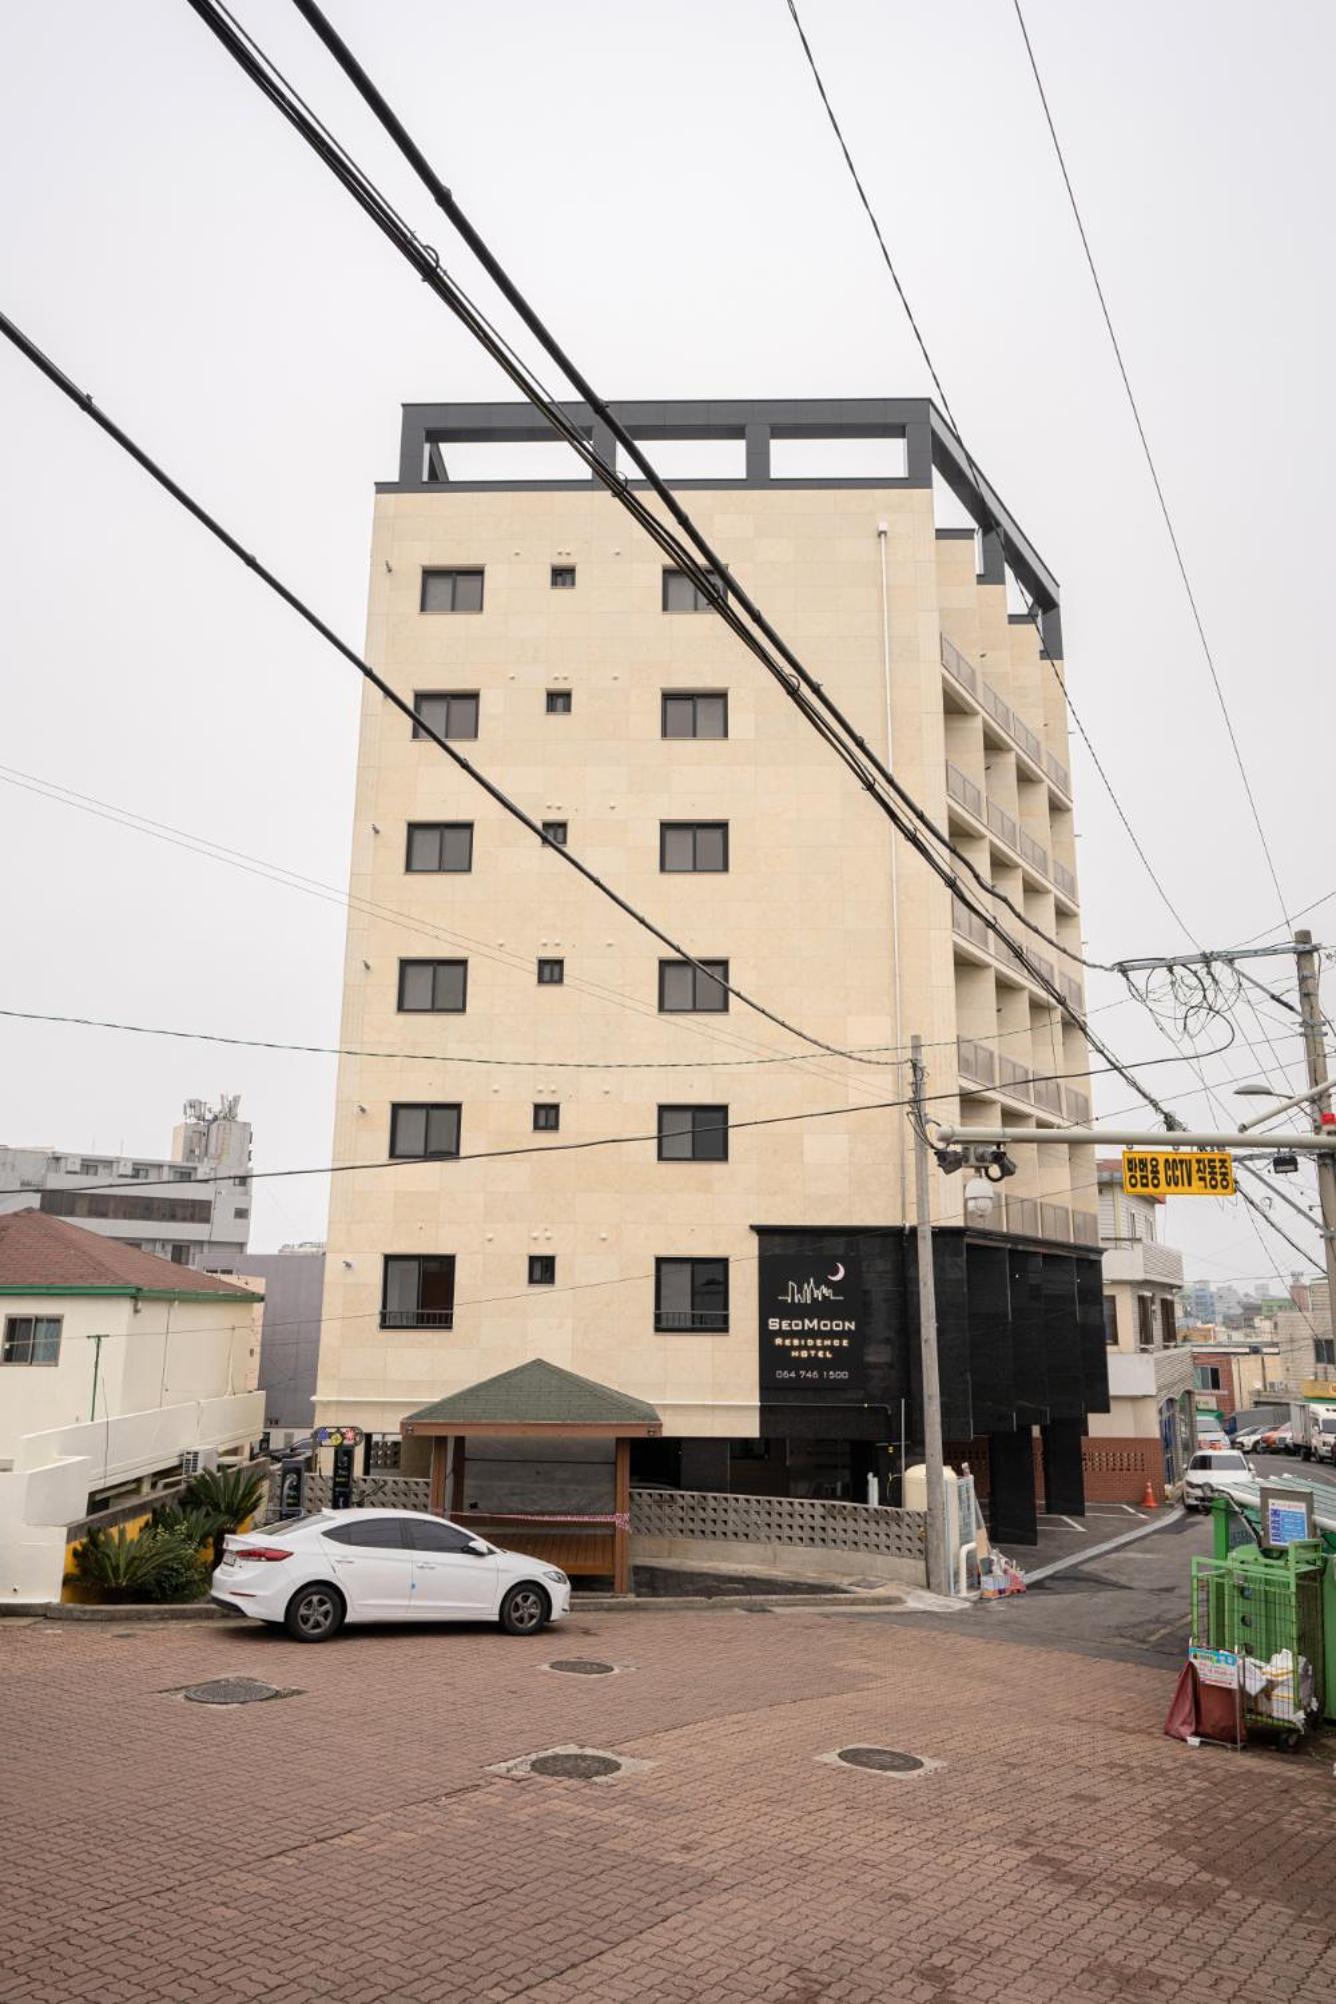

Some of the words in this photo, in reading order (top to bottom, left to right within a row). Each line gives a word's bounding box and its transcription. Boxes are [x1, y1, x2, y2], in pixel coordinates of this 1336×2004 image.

[1127, 1157, 1160, 1189] 방범용
[1164, 1158, 1192, 1188] CCTV
[1196, 1158, 1230, 1190] 작동중
[791, 1350, 833, 1358] HOTEL
[775, 1370, 797, 1379] 064
